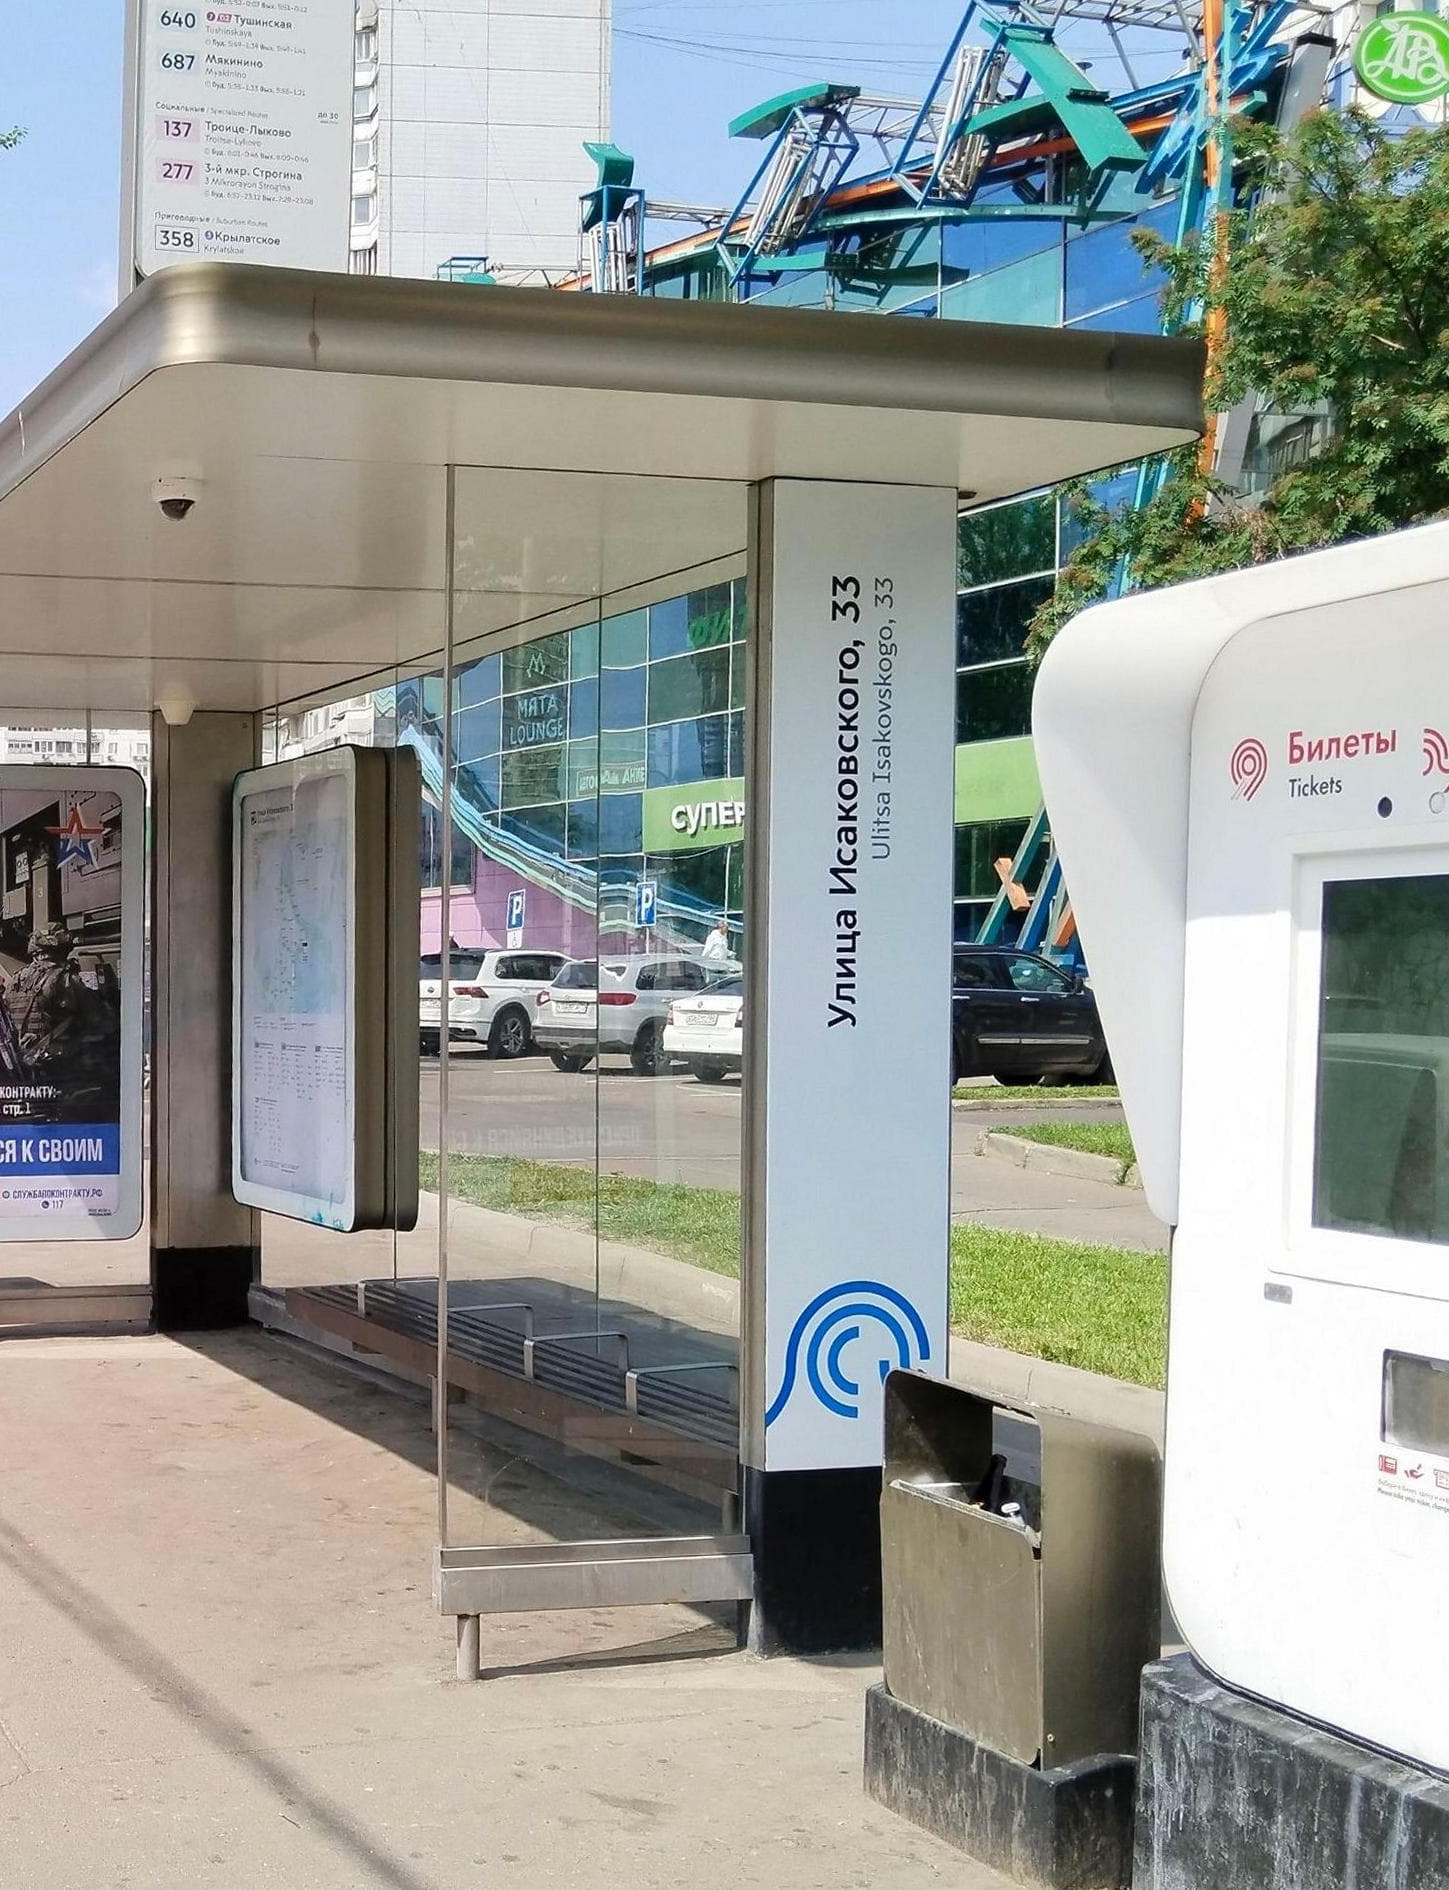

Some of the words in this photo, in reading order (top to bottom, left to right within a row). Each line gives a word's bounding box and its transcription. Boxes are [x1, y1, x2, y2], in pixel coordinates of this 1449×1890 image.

[160, 10, 196, 28] 640
[235, 14, 293, 30] Тушинская
[161, 53, 195, 71] 687
[205, 54, 264, 69] Мякинино
[155, 101, 205, 113] Социальные
[163, 120, 192, 138] 137
[205, 121, 292, 139] Троице-Лыково
[162, 163, 193, 181] 277
[205, 163, 223, 175] 3-й
[226, 165, 250, 179] мкр.
[252, 166, 303, 181] Строгина
[160, 230, 194, 248] 358
[215, 229, 281, 246] Крылатское
[831, 575, 861, 623] 33
[874, 577, 894, 608] 33
[518, 693, 559, 718] МЯТА
[872, 617, 898, 784] Isakovskogo,
[510, 717, 565, 745] LOUNGE
[1288, 729, 1397, 765] Билеты
[829, 639, 865, 895] Исаковского,
[1288, 774, 1343, 798] Tickets
[671, 801, 746, 836] СУПЕР
[872, 792, 891, 860] Ulitsa
[828, 910, 861, 1027] Улица
[21, 1140, 34, 1162] К
[39, 1138, 103, 1162] СВОИМ
[52, 1200, 64, 1209] 117
